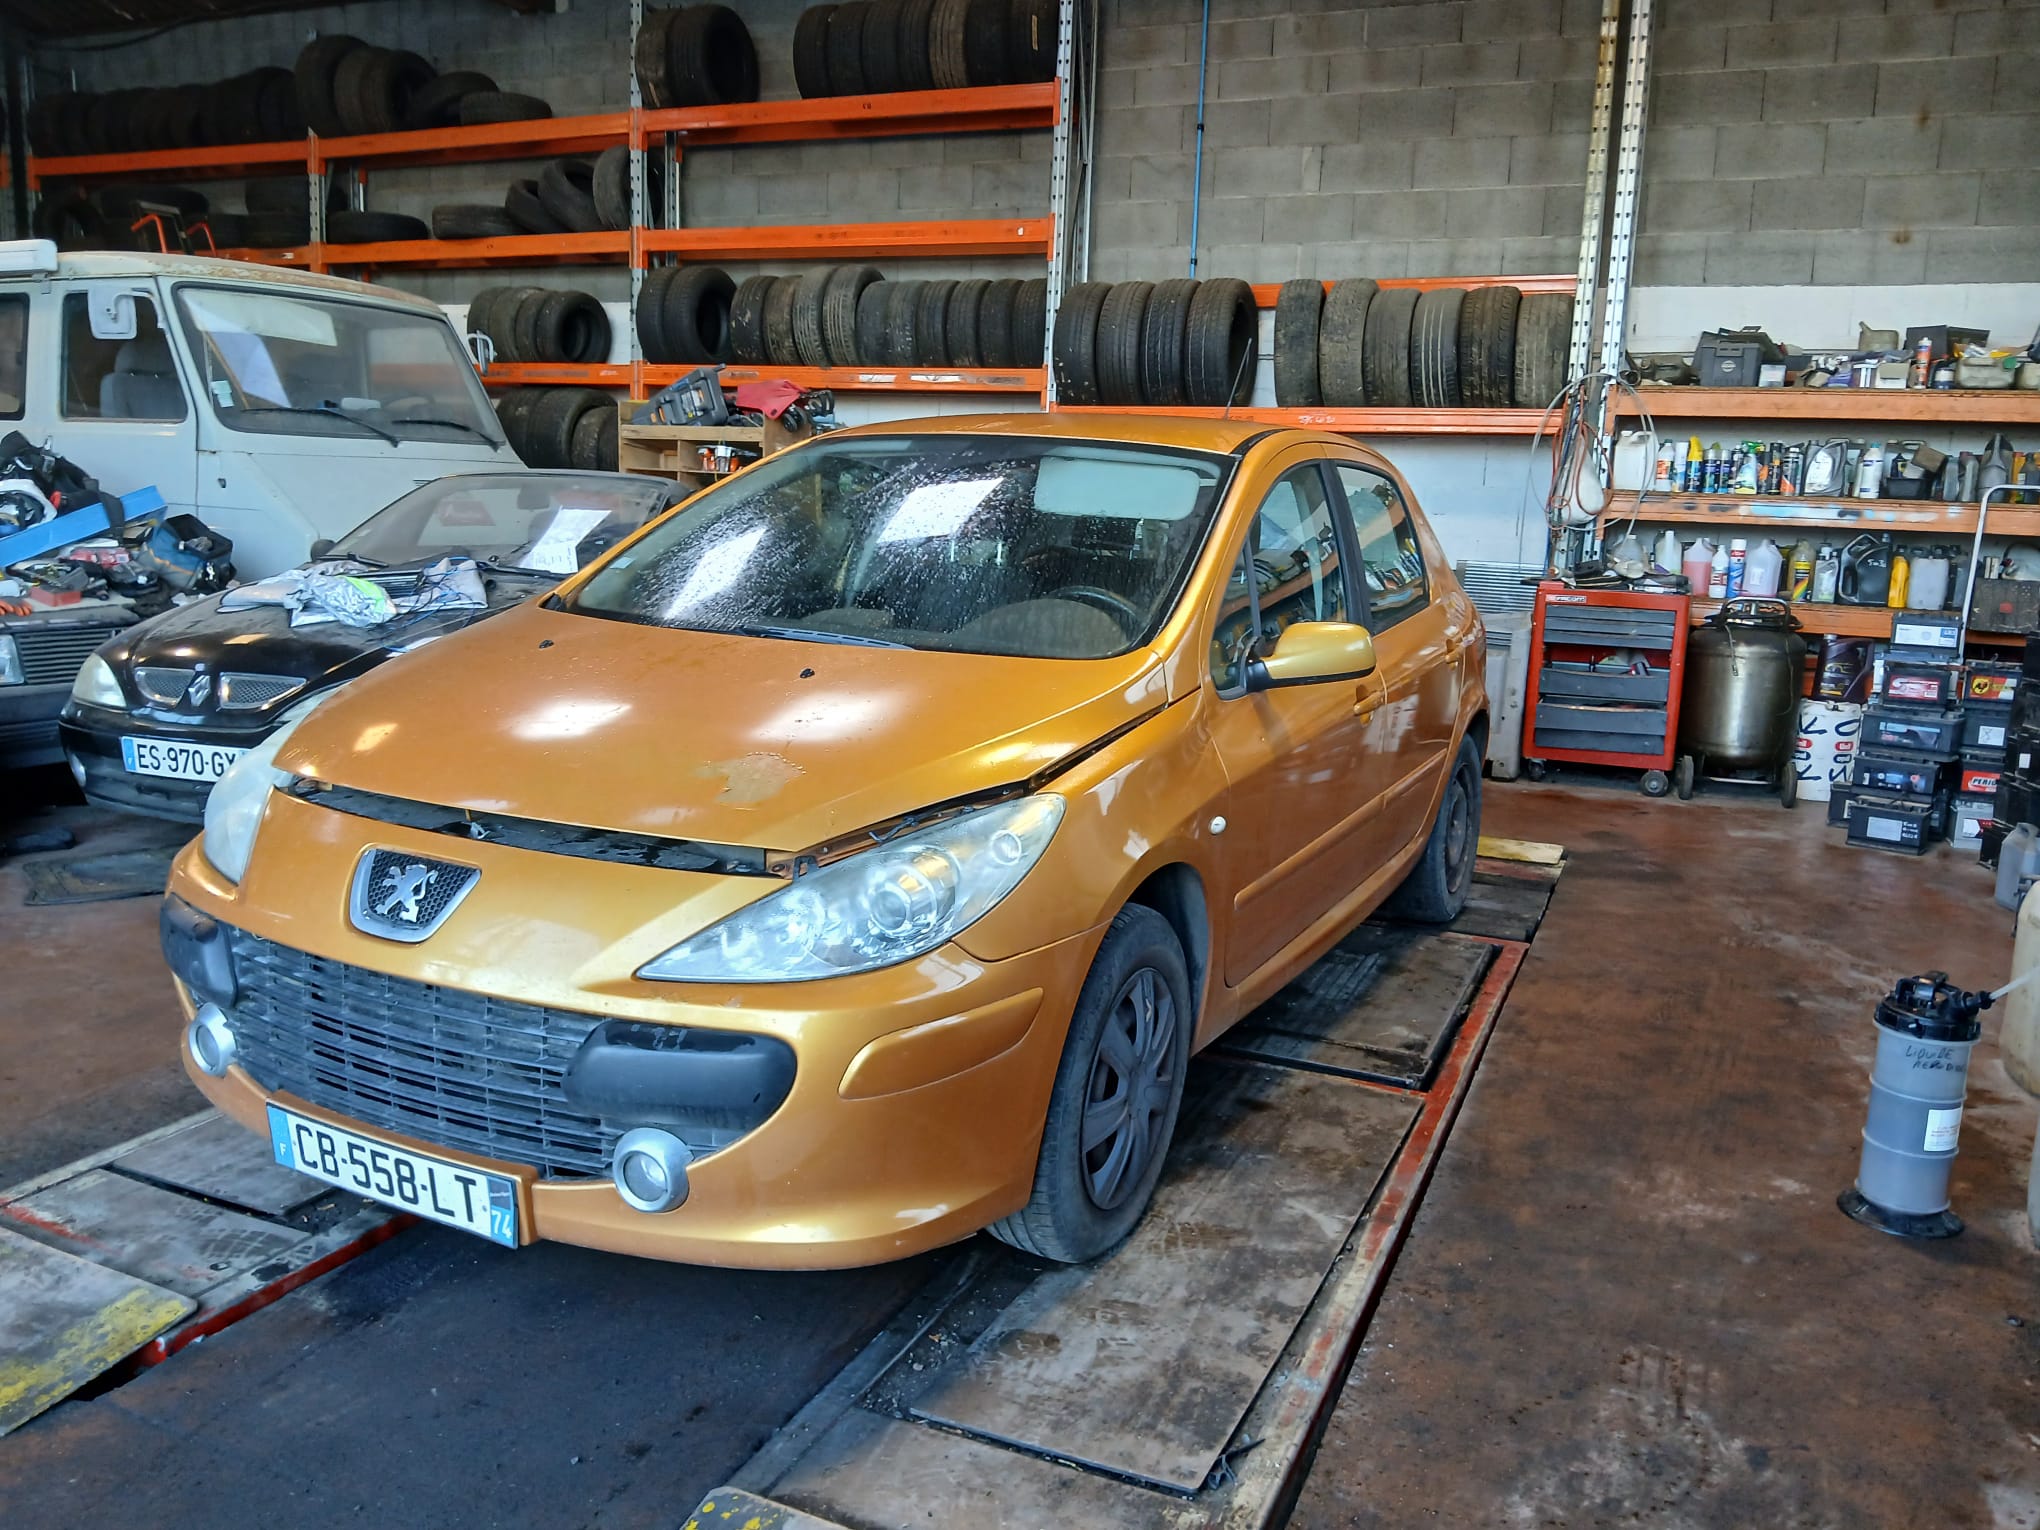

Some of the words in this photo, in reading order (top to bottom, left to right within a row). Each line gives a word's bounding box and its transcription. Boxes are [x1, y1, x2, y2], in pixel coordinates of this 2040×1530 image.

[279, 1143, 287, 1156] F
[296, 1124, 476, 1223] CB-558-LT
[491, 1209, 513, 1240] 74
